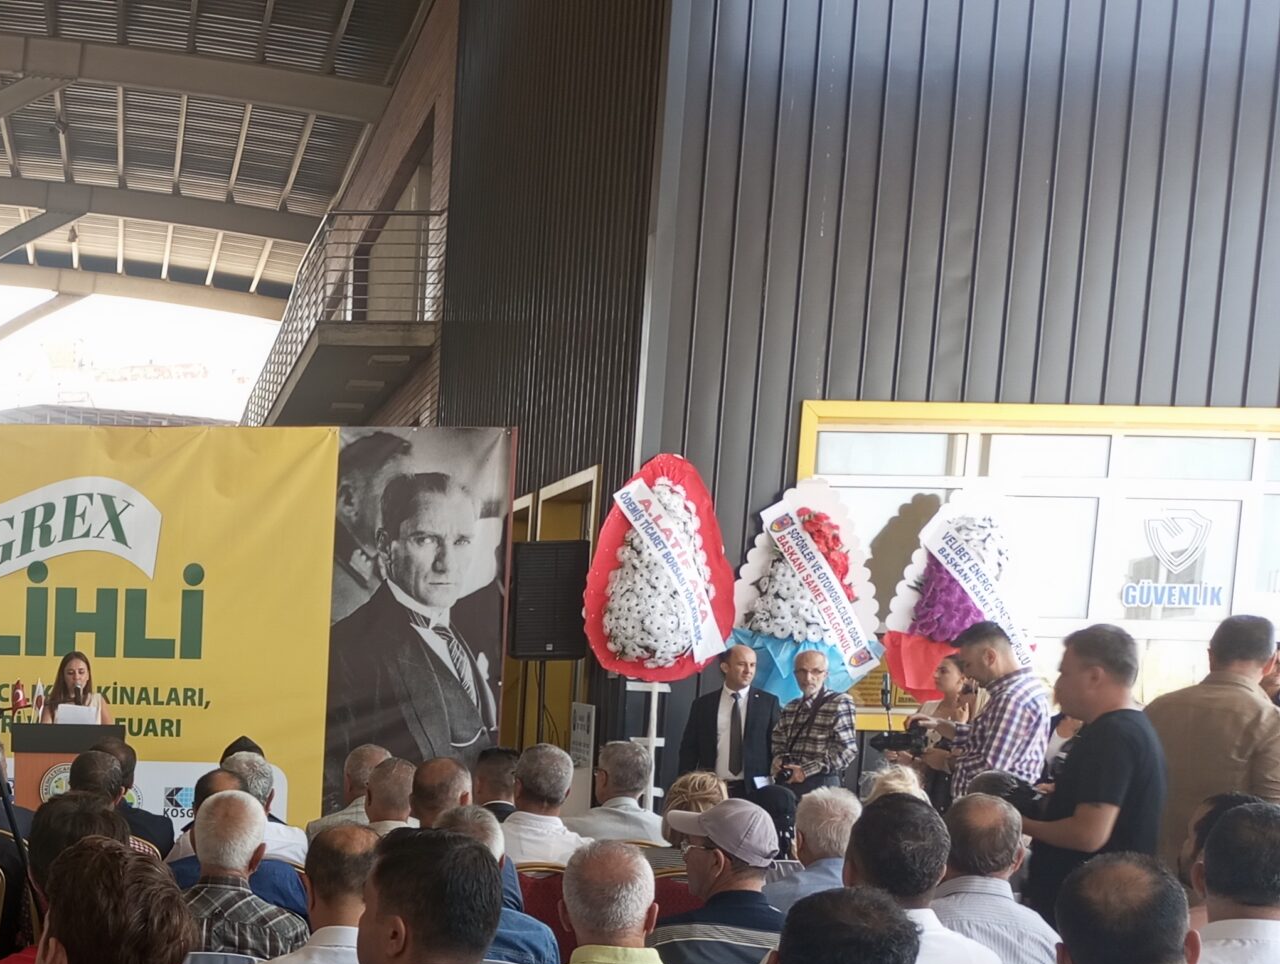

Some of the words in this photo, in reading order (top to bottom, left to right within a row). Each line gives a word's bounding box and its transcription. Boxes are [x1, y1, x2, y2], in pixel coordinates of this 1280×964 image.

[662, 550, 687, 587] BORSASI
[811, 561, 823, 574] VE
[969, 563, 994, 595] ENERGY
[802, 573, 827, 605] SAMET
[970, 584, 993, 613] SAMET
[1123, 581, 1223, 606] GÜVENLİK
